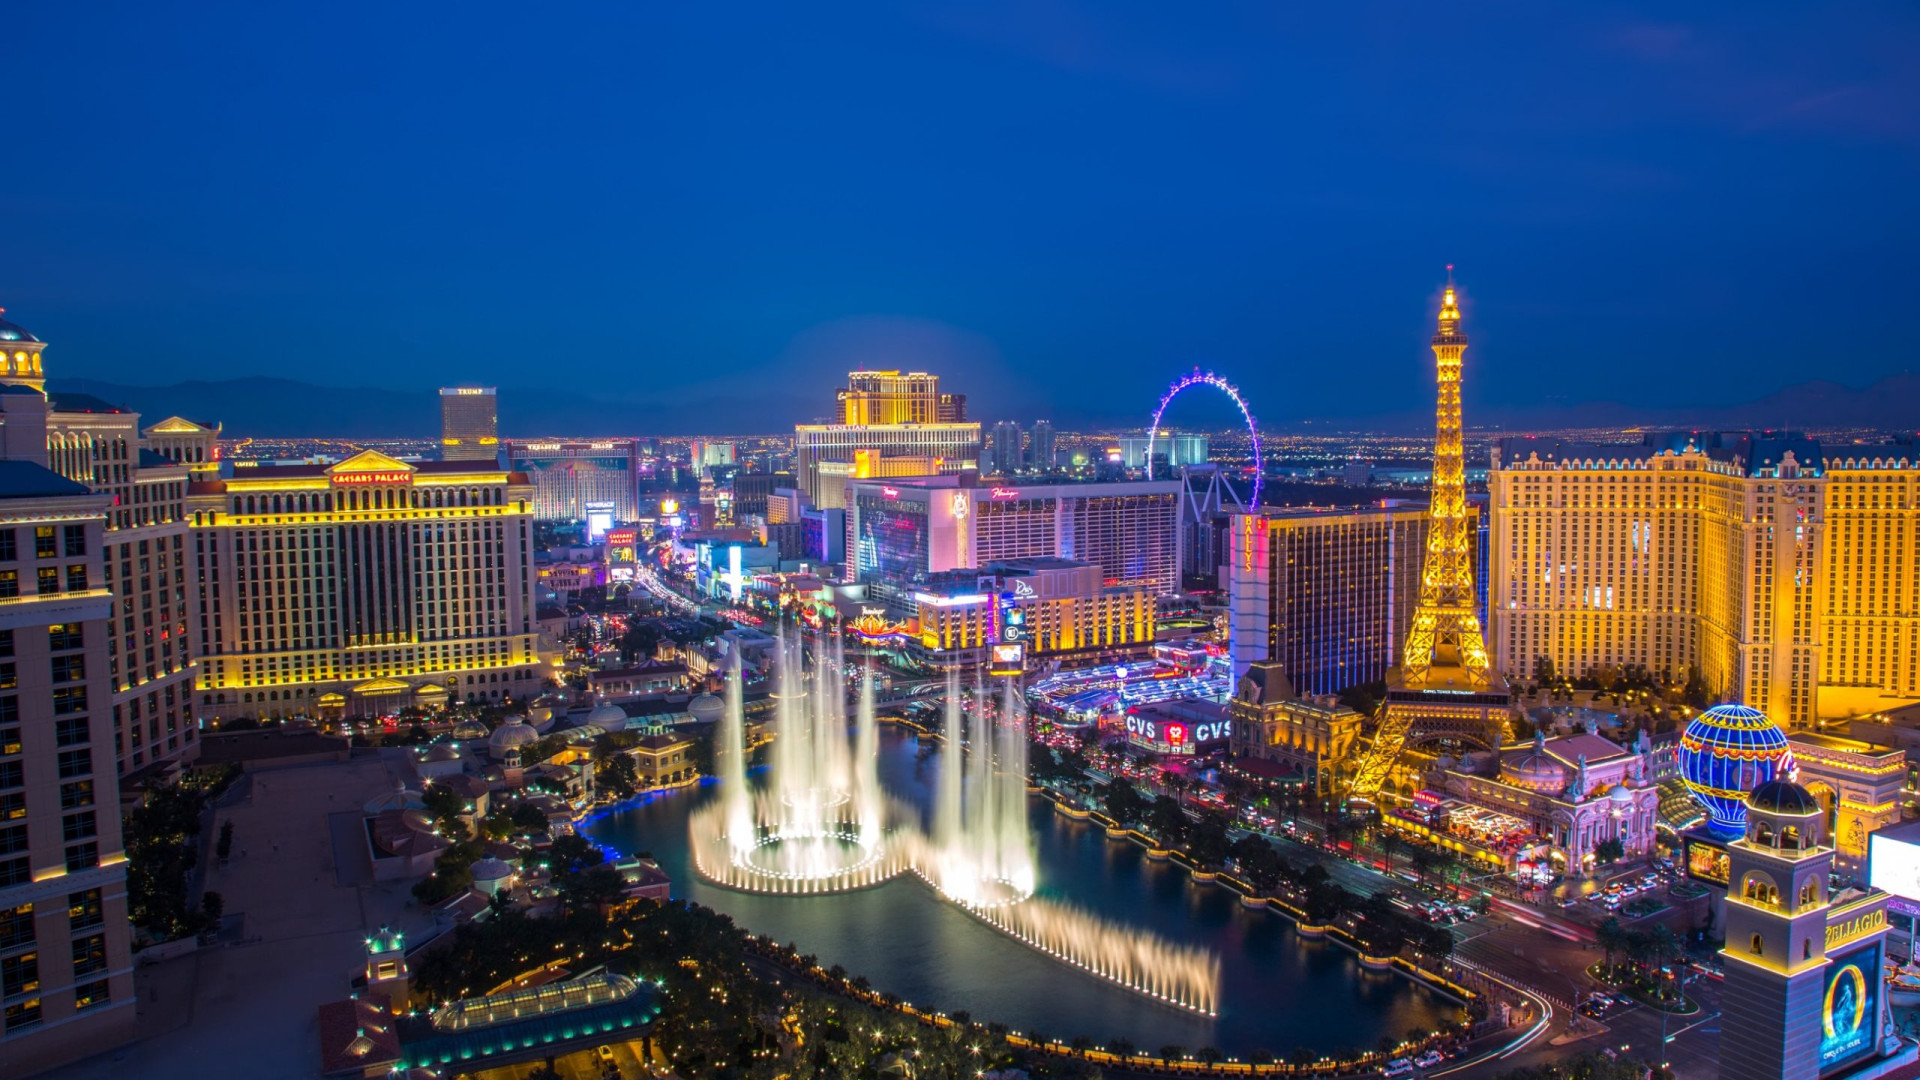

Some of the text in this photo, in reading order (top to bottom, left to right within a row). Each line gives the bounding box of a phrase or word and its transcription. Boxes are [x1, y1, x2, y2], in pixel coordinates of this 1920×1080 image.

[333, 473, 409, 483] CAESARS PALACE
[1126, 715, 1155, 738] CVS
[1196, 720, 1231, 741] CVS
